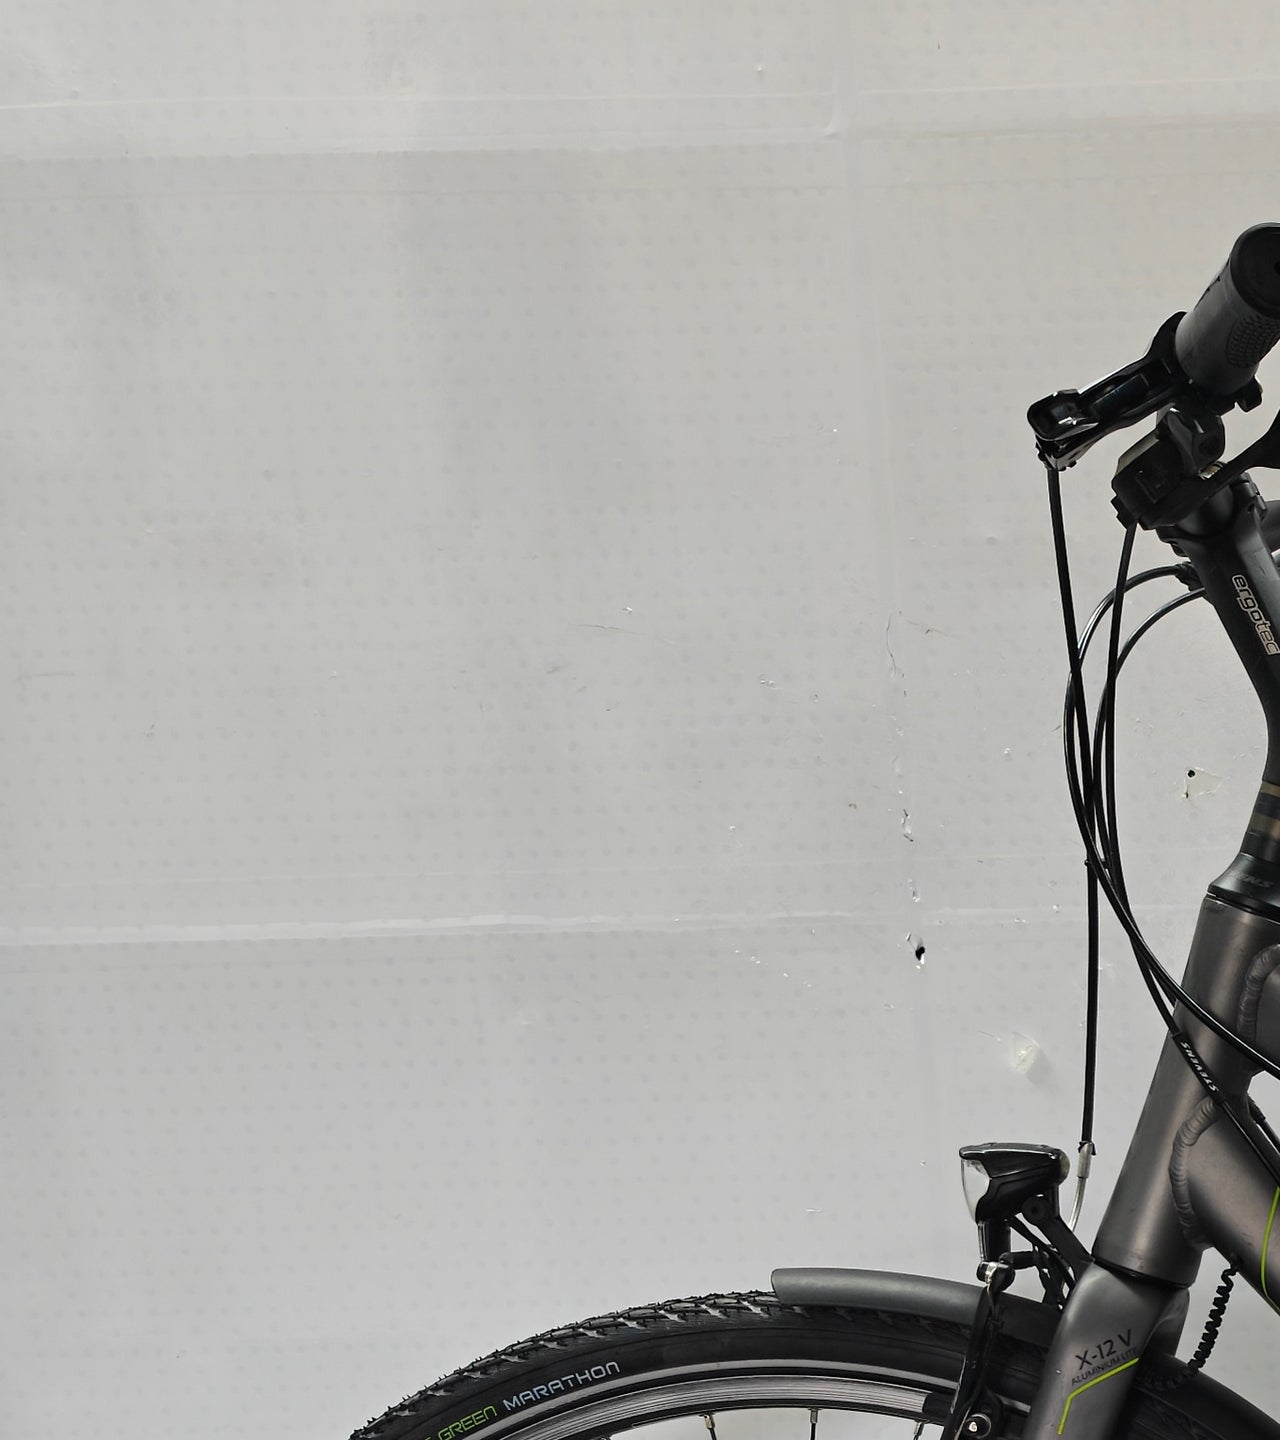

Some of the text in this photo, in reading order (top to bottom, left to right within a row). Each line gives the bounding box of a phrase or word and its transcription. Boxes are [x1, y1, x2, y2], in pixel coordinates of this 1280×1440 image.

[1231, 574, 1280, 655] ergotec
[1180, 1041, 1219, 1092] STEVENS
[1075, 1328, 1132, 1370] X-12 V
[502, 1361, 621, 1412] MARATHON
